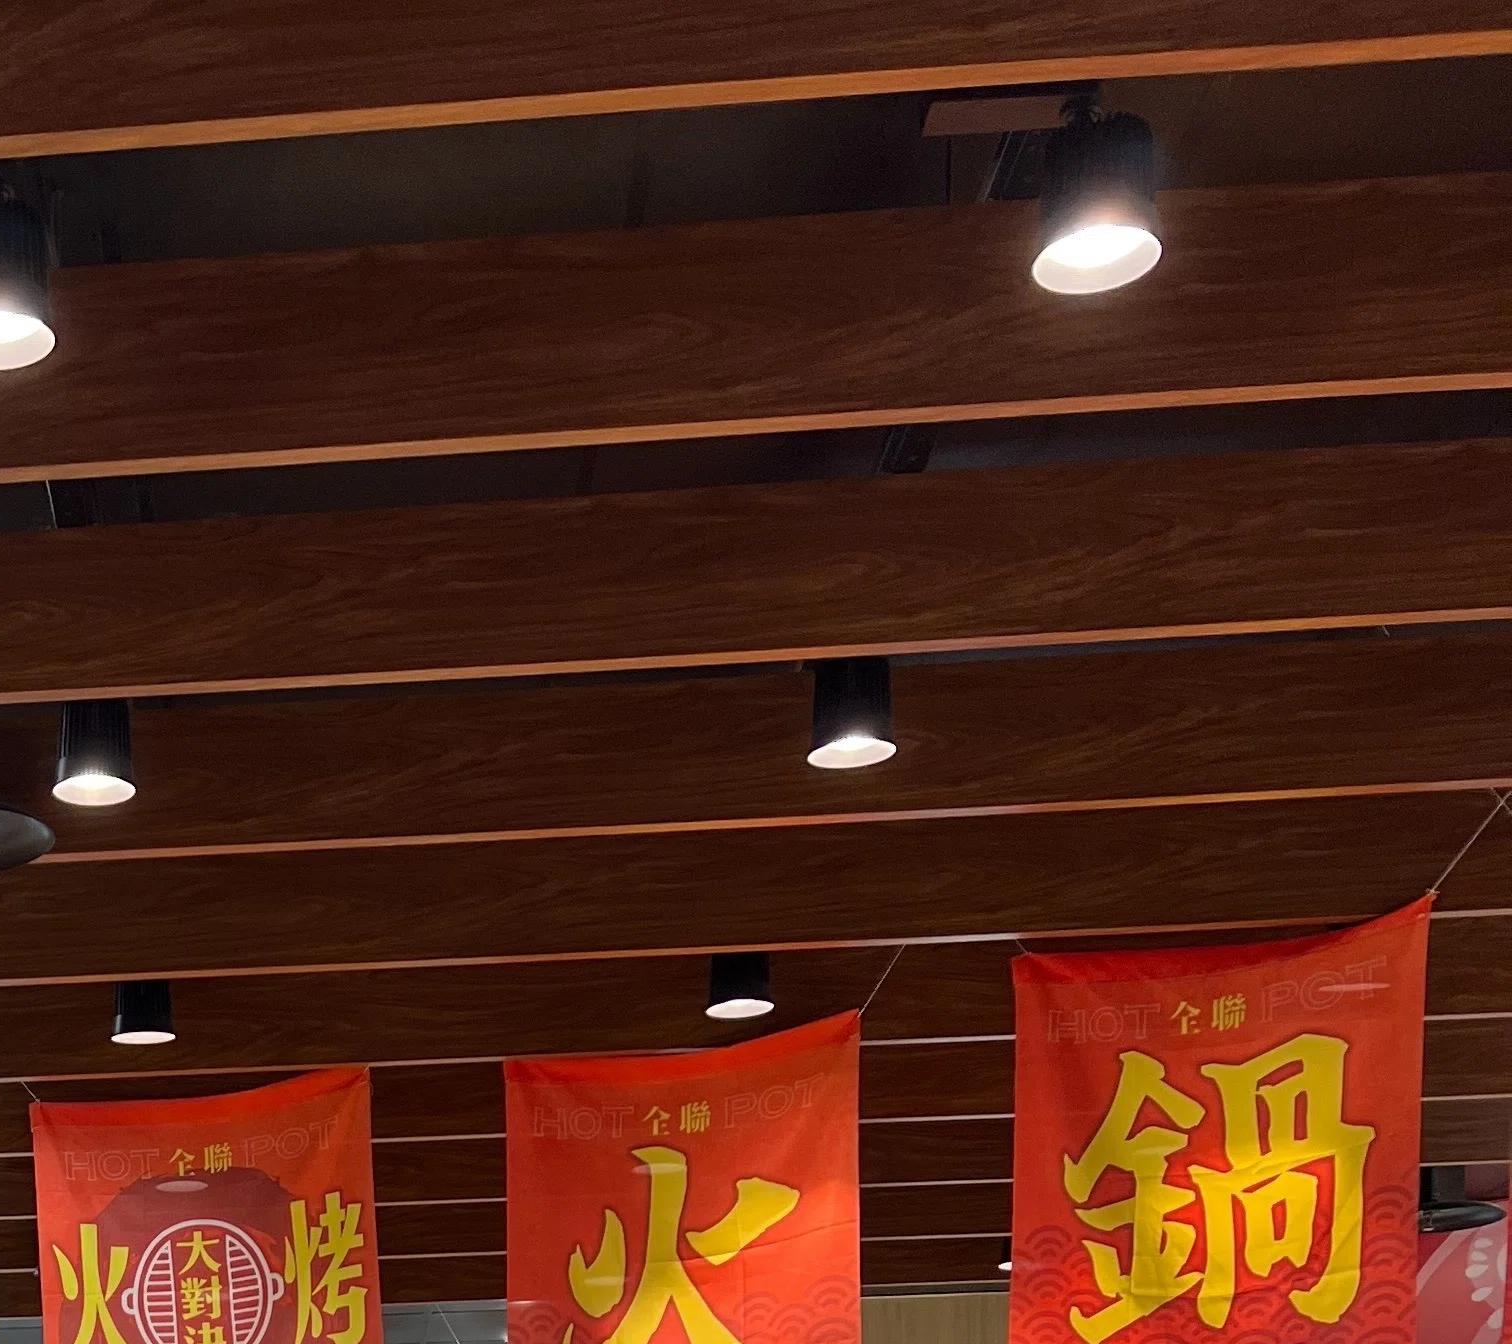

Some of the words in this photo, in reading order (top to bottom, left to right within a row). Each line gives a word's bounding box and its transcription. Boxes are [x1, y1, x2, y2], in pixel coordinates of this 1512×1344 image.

[1171, 992, 1247, 1035] 全聯
[642, 1101, 711, 1137] 全聯
[169, 1141, 233, 1177] 全聯
